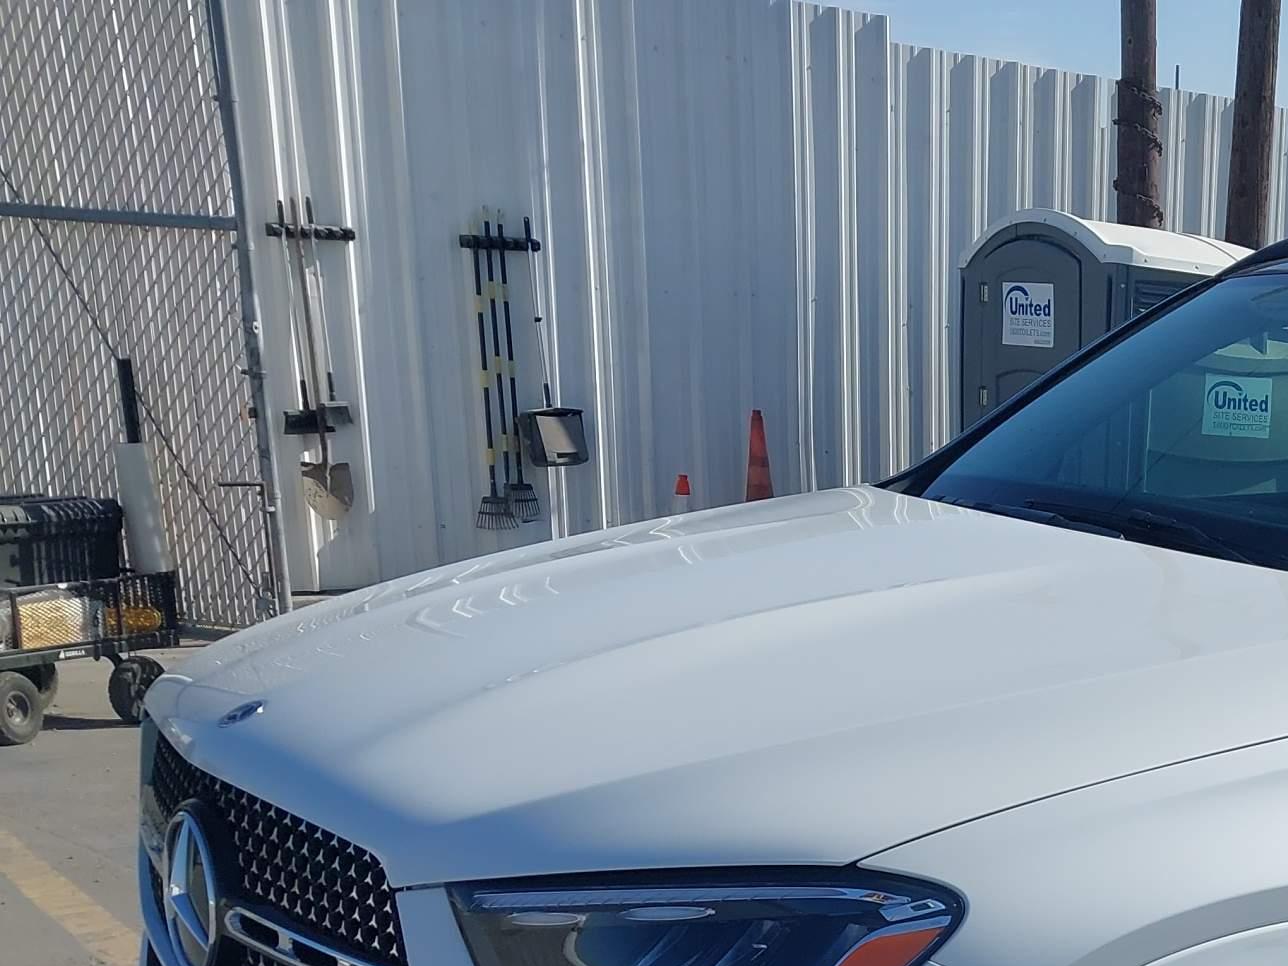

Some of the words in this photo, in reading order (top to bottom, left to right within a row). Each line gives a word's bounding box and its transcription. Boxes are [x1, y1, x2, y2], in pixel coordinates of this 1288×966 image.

[1010, 296, 1051, 317] United
[1022, 318, 1052, 328] SERVICES
[1214, 390, 1269, 413] United
[1213, 411, 1231, 421] SITE
[1232, 412, 1268, 423] SERVICES
